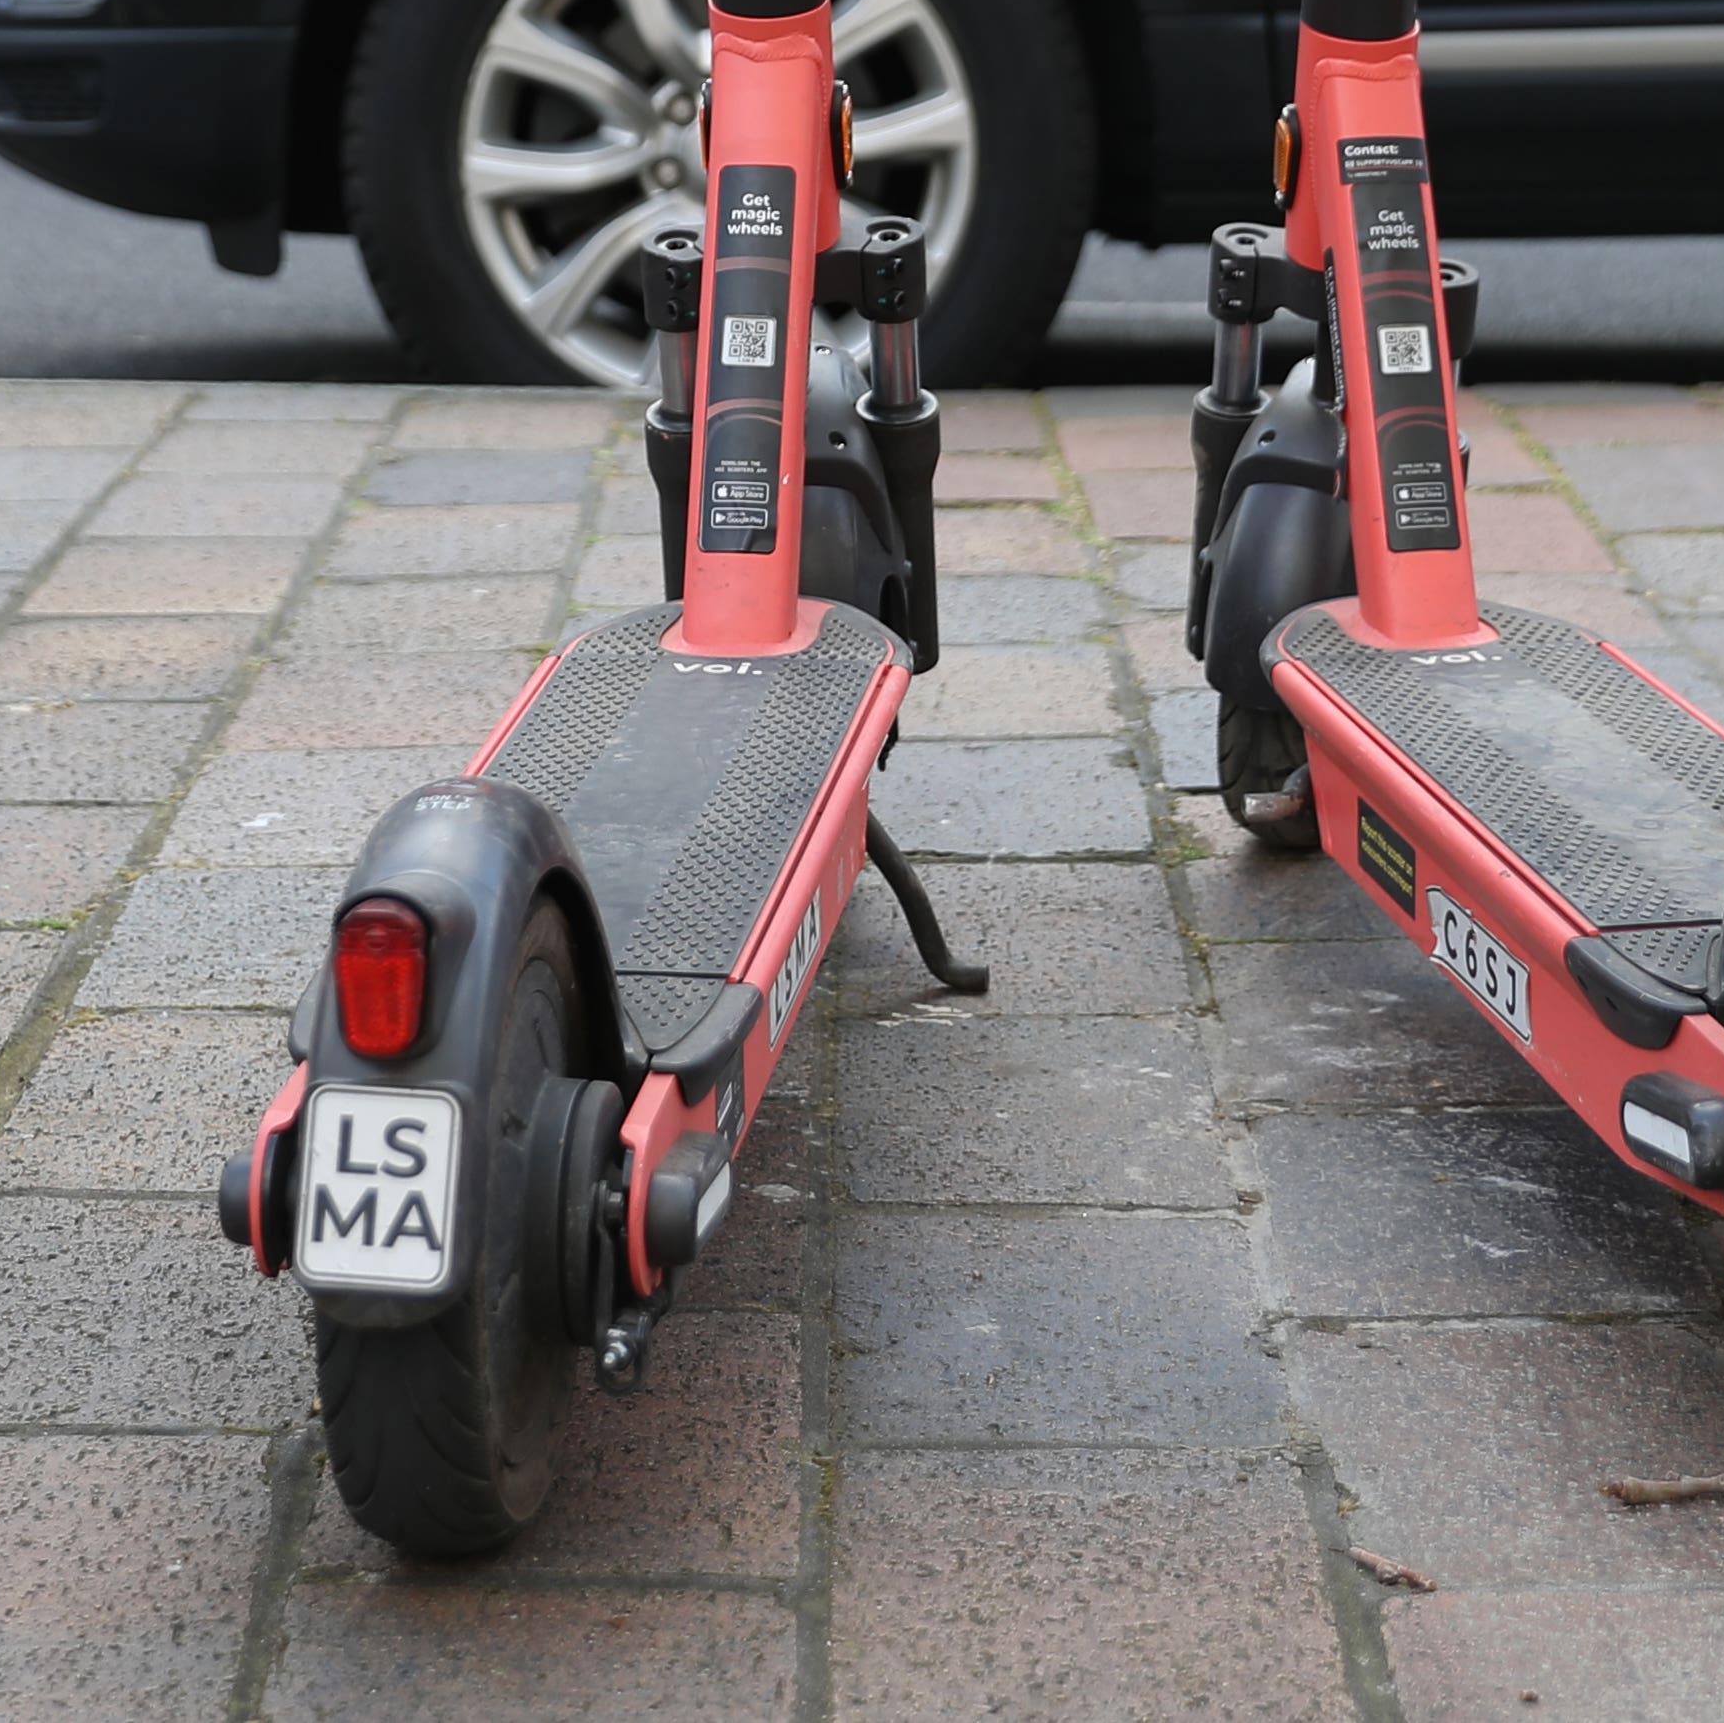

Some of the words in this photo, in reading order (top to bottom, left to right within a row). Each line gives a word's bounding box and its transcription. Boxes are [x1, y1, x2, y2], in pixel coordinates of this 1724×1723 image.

[1344, 145, 1399, 156] Contact:
[742, 193, 771, 207] Get
[731, 207, 781, 223] magic
[1378, 210, 1405, 222] Get
[727, 222, 783, 236] wheels
[1369, 222, 1415, 237] magic
[1367, 237, 1420, 250] wheels
[730, 490, 744, 498] App
[746, 490, 764, 498] Store
[750, 516, 763, 524] Play
[1410, 650, 1503, 664] voi.
[673, 662, 763, 675] voi.
[415, 801, 470, 811] STEP
[1444, 910, 1516, 1016] C6SJ
[336, 1113, 428, 1179] LS
[311, 1183, 442, 1251] MA
